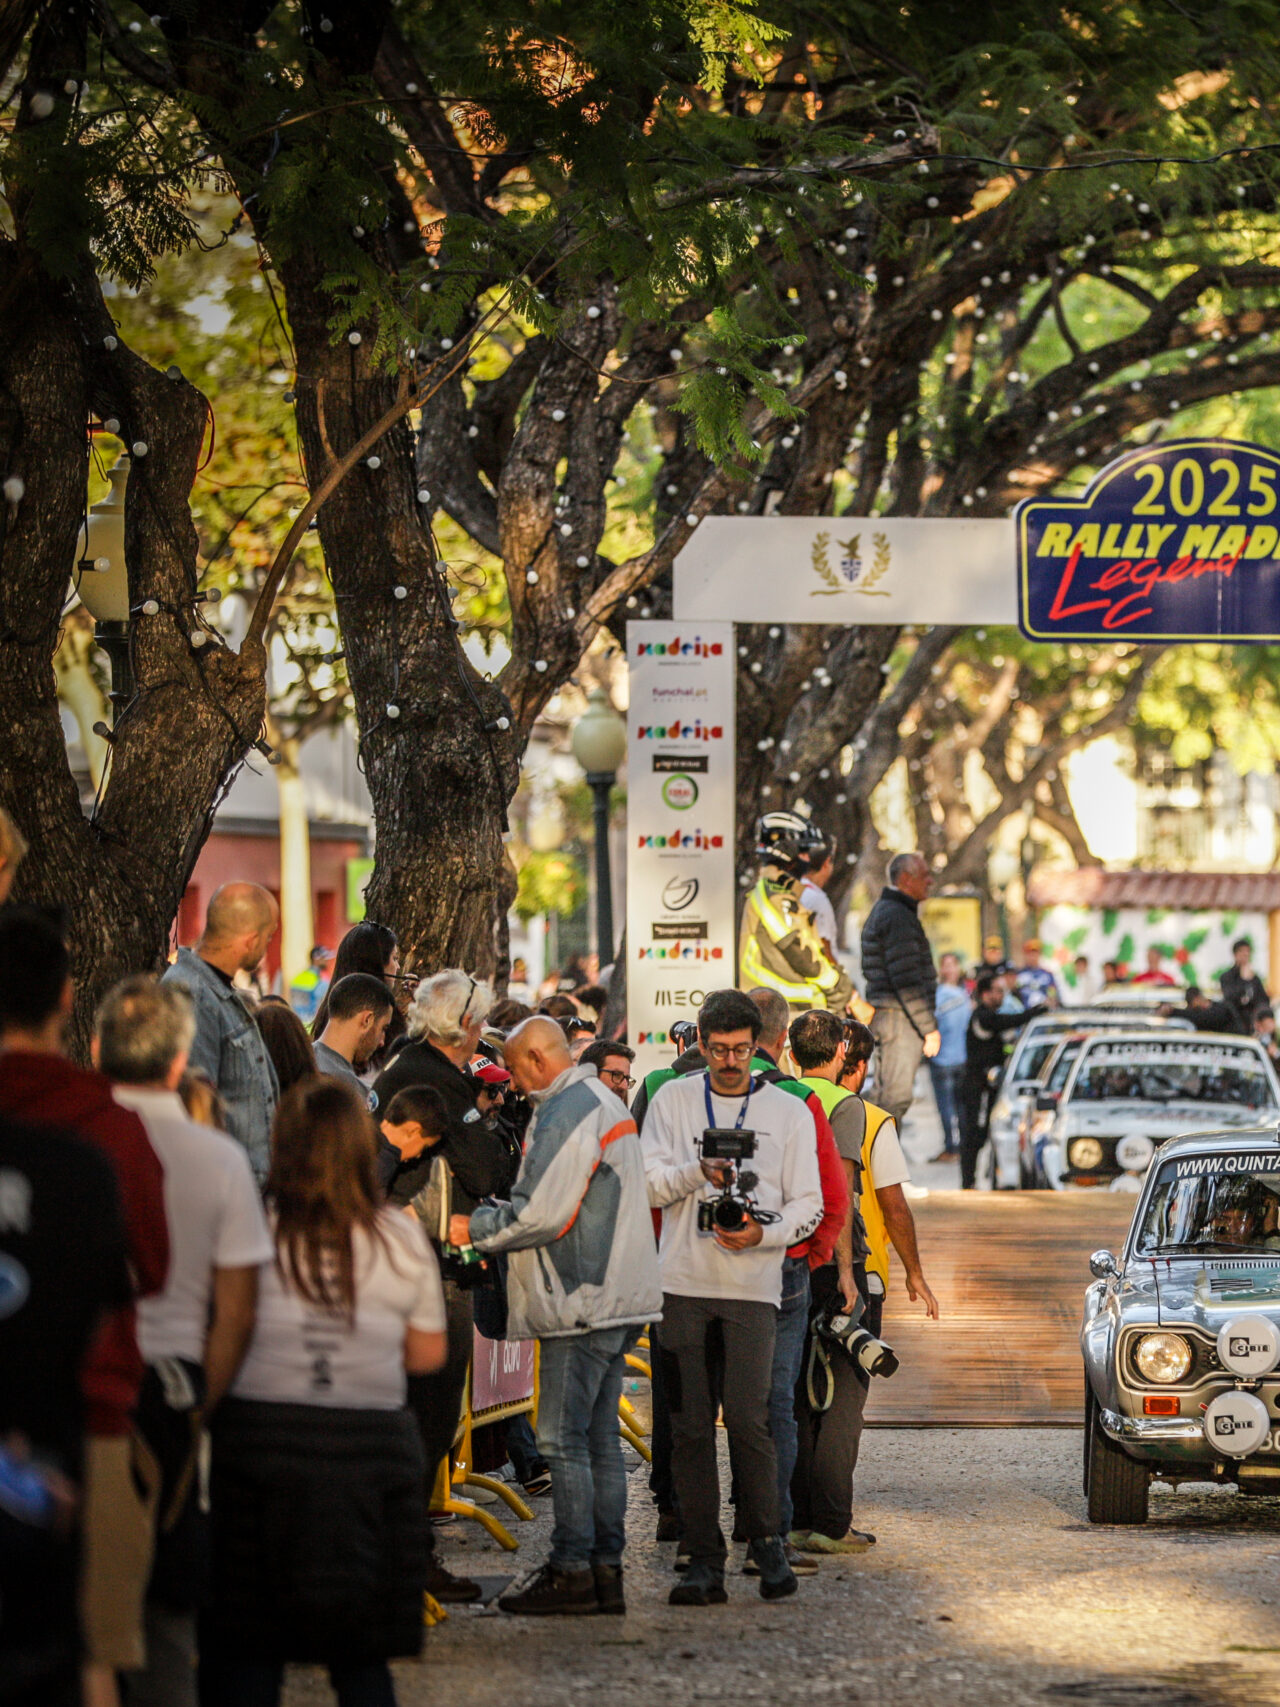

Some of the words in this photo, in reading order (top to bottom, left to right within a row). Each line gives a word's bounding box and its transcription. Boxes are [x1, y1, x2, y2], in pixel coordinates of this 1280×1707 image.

[1132, 457, 1277, 517] 2025
[1035, 522, 1177, 558] RALLY
[1048, 535, 1252, 630] Legend
[637, 635, 723, 658] madeira
[637, 719, 723, 741] madeira
[638, 827, 723, 851] madeira
[655, 990, 705, 1007] MEO
